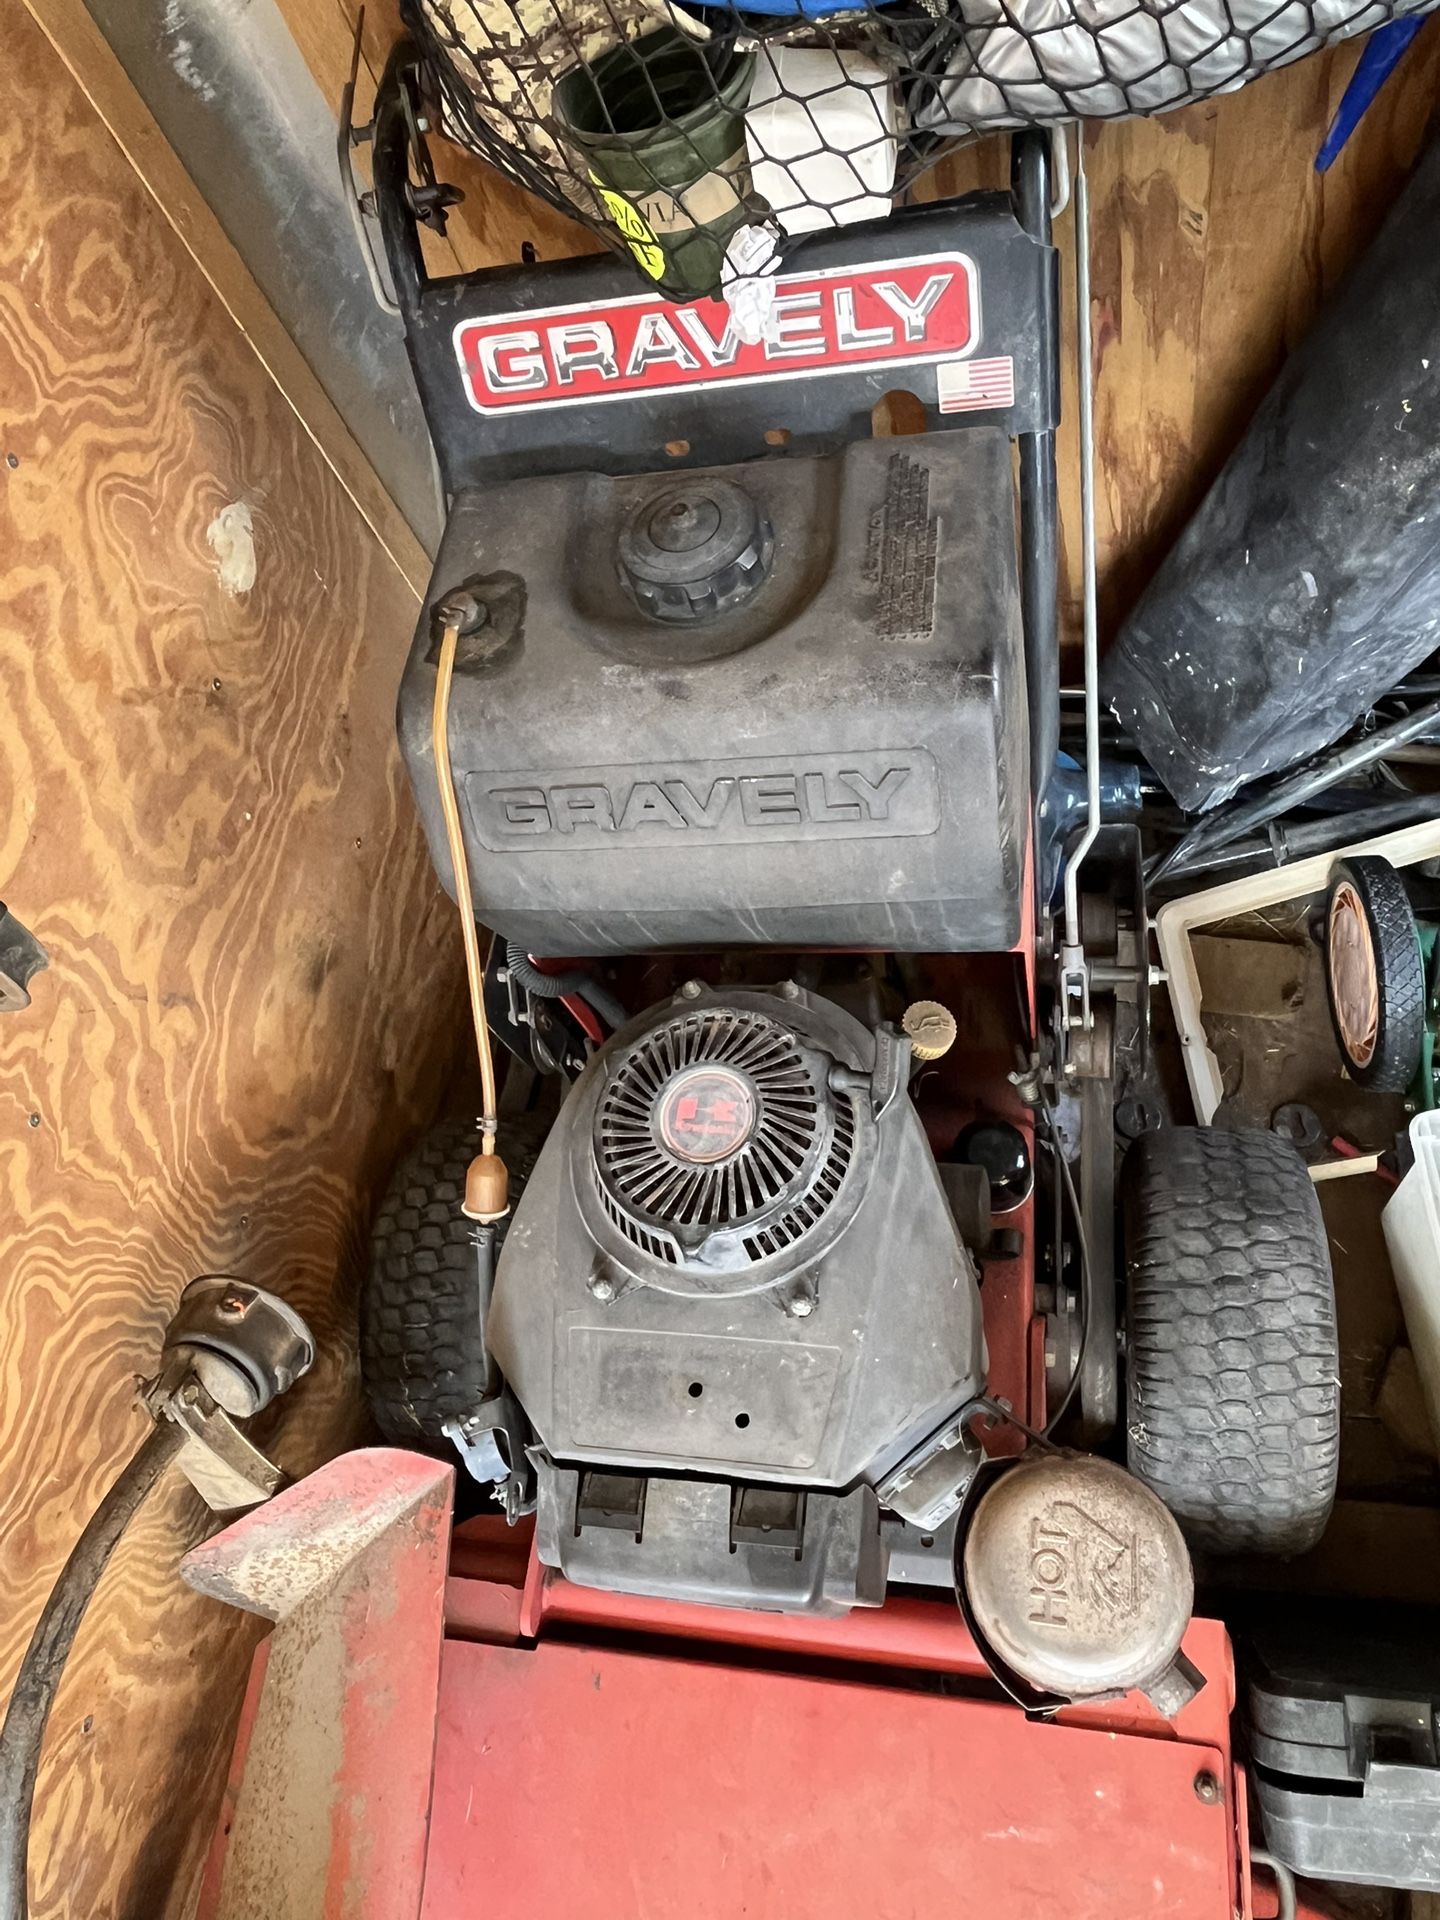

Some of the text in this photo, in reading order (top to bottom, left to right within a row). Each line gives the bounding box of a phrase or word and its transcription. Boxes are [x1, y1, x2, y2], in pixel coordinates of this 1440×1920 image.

[477, 273, 955, 394] GRAVELY
[488, 767, 911, 835] GRAVELY
[1028, 1516, 1069, 1629] HOT
